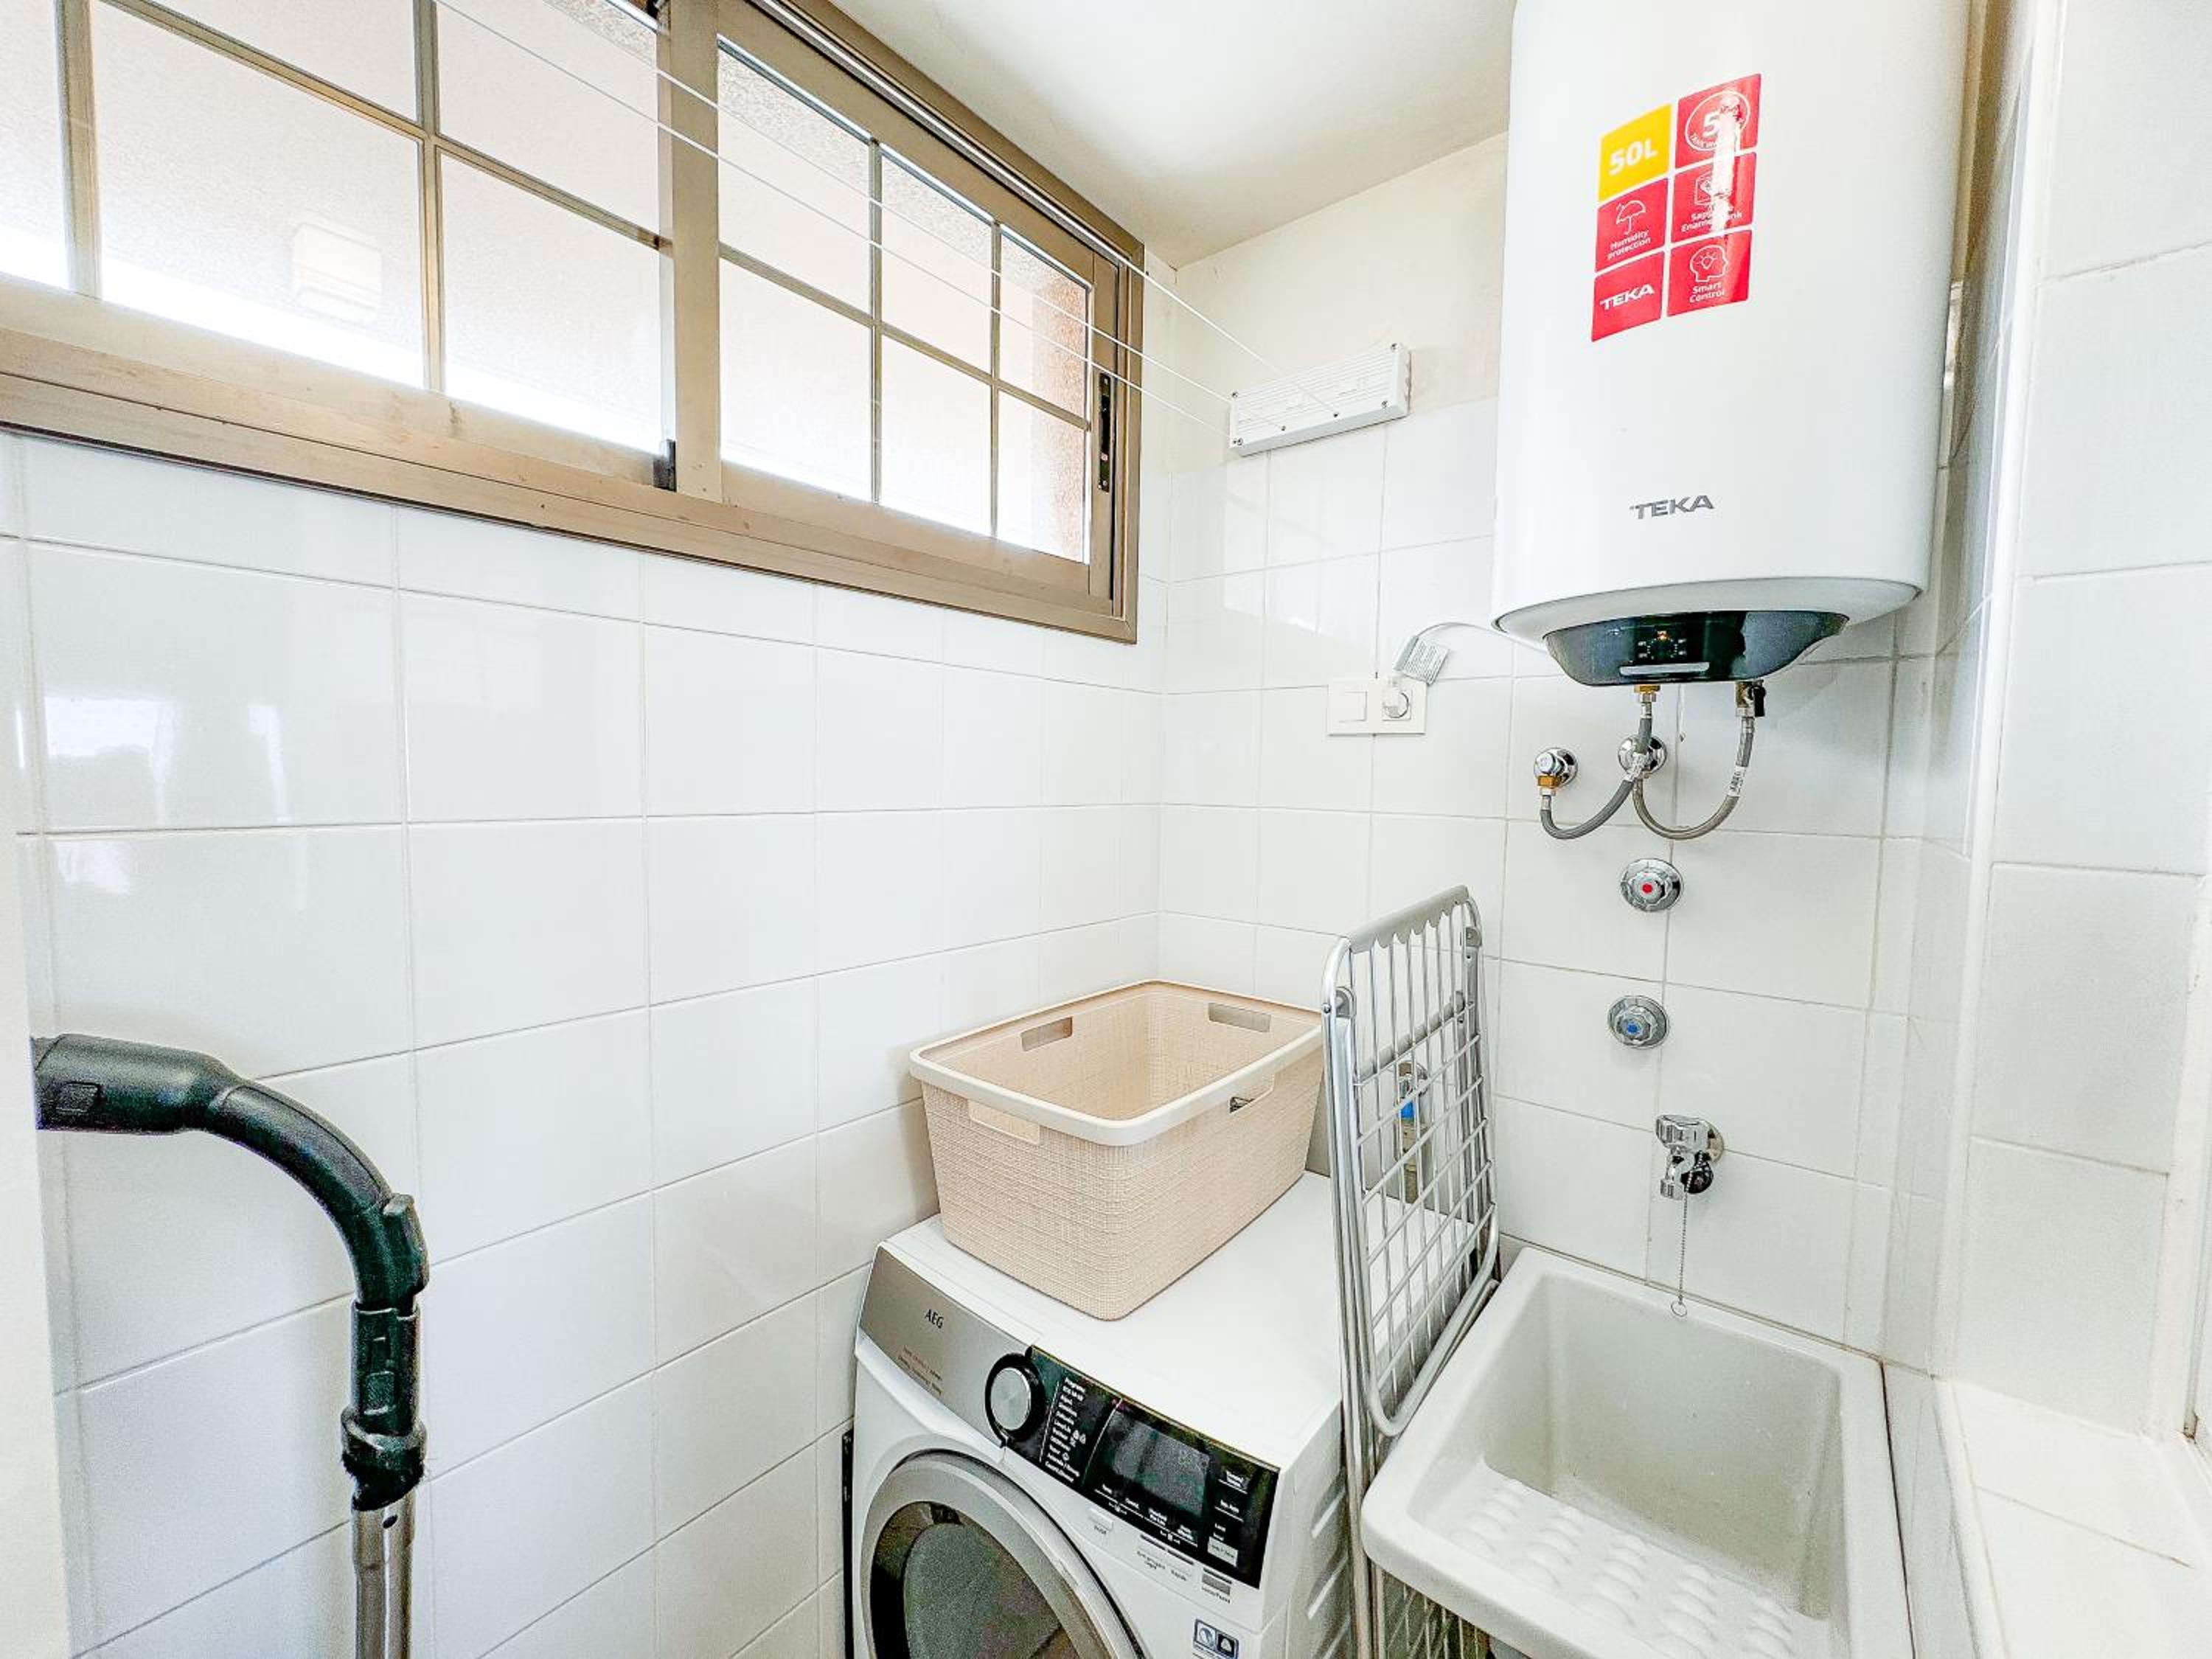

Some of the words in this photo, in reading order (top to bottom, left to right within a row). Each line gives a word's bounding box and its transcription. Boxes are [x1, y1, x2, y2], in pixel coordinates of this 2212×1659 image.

[1608, 139, 1658, 175] 50L
[1607, 237, 1650, 260] protection
[1610, 230, 1649, 251] Humidity
[1599, 284, 1655, 310] TEKA
[1690, 291, 1724, 303] Control
[1693, 282, 1721, 293] Smart
[1629, 495, 1714, 520] TEKA
[925, 1309, 944, 1329] AEG
